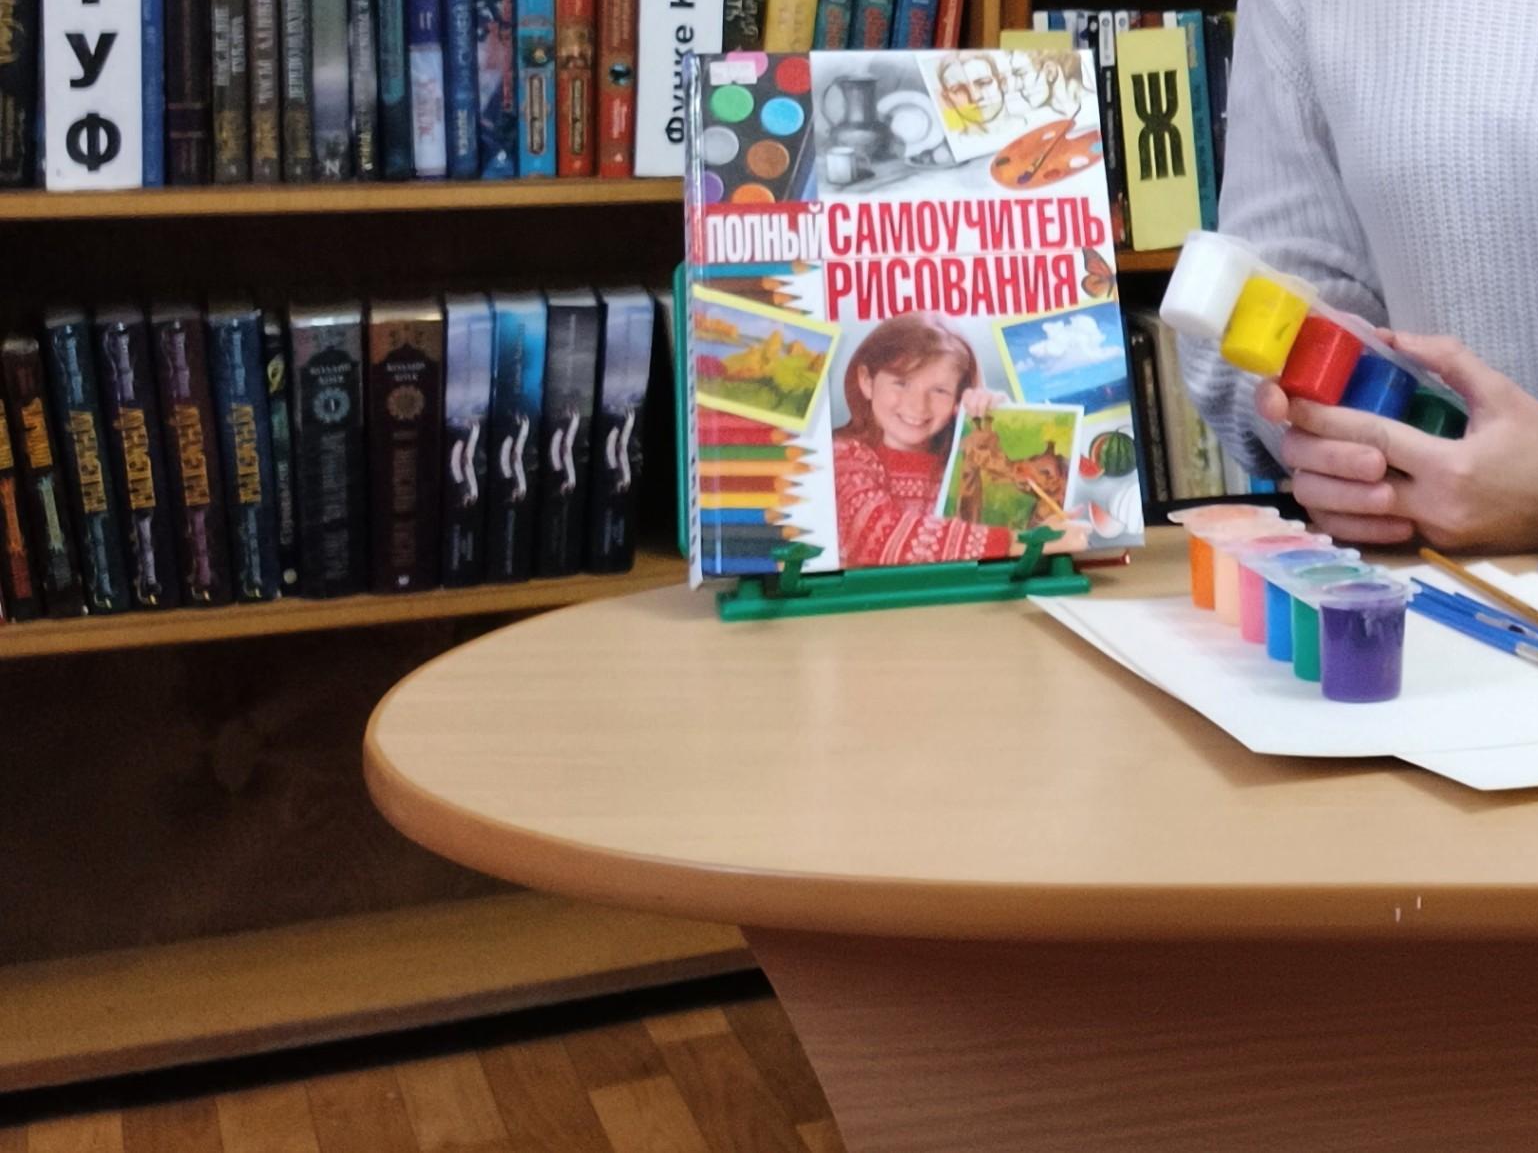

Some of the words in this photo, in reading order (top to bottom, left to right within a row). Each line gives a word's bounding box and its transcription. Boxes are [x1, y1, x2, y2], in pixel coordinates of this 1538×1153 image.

[65, 31, 119, 88] У
[65, 112, 121, 171] Ф
[1131, 70, 1187, 181] Ж
[706, 203, 825, 264] ПОЛНЫЙ
[827, 196, 1105, 255] САМОУЧИТЕЛЬ
[826, 254, 1079, 322] РИСОВАНИЯ
